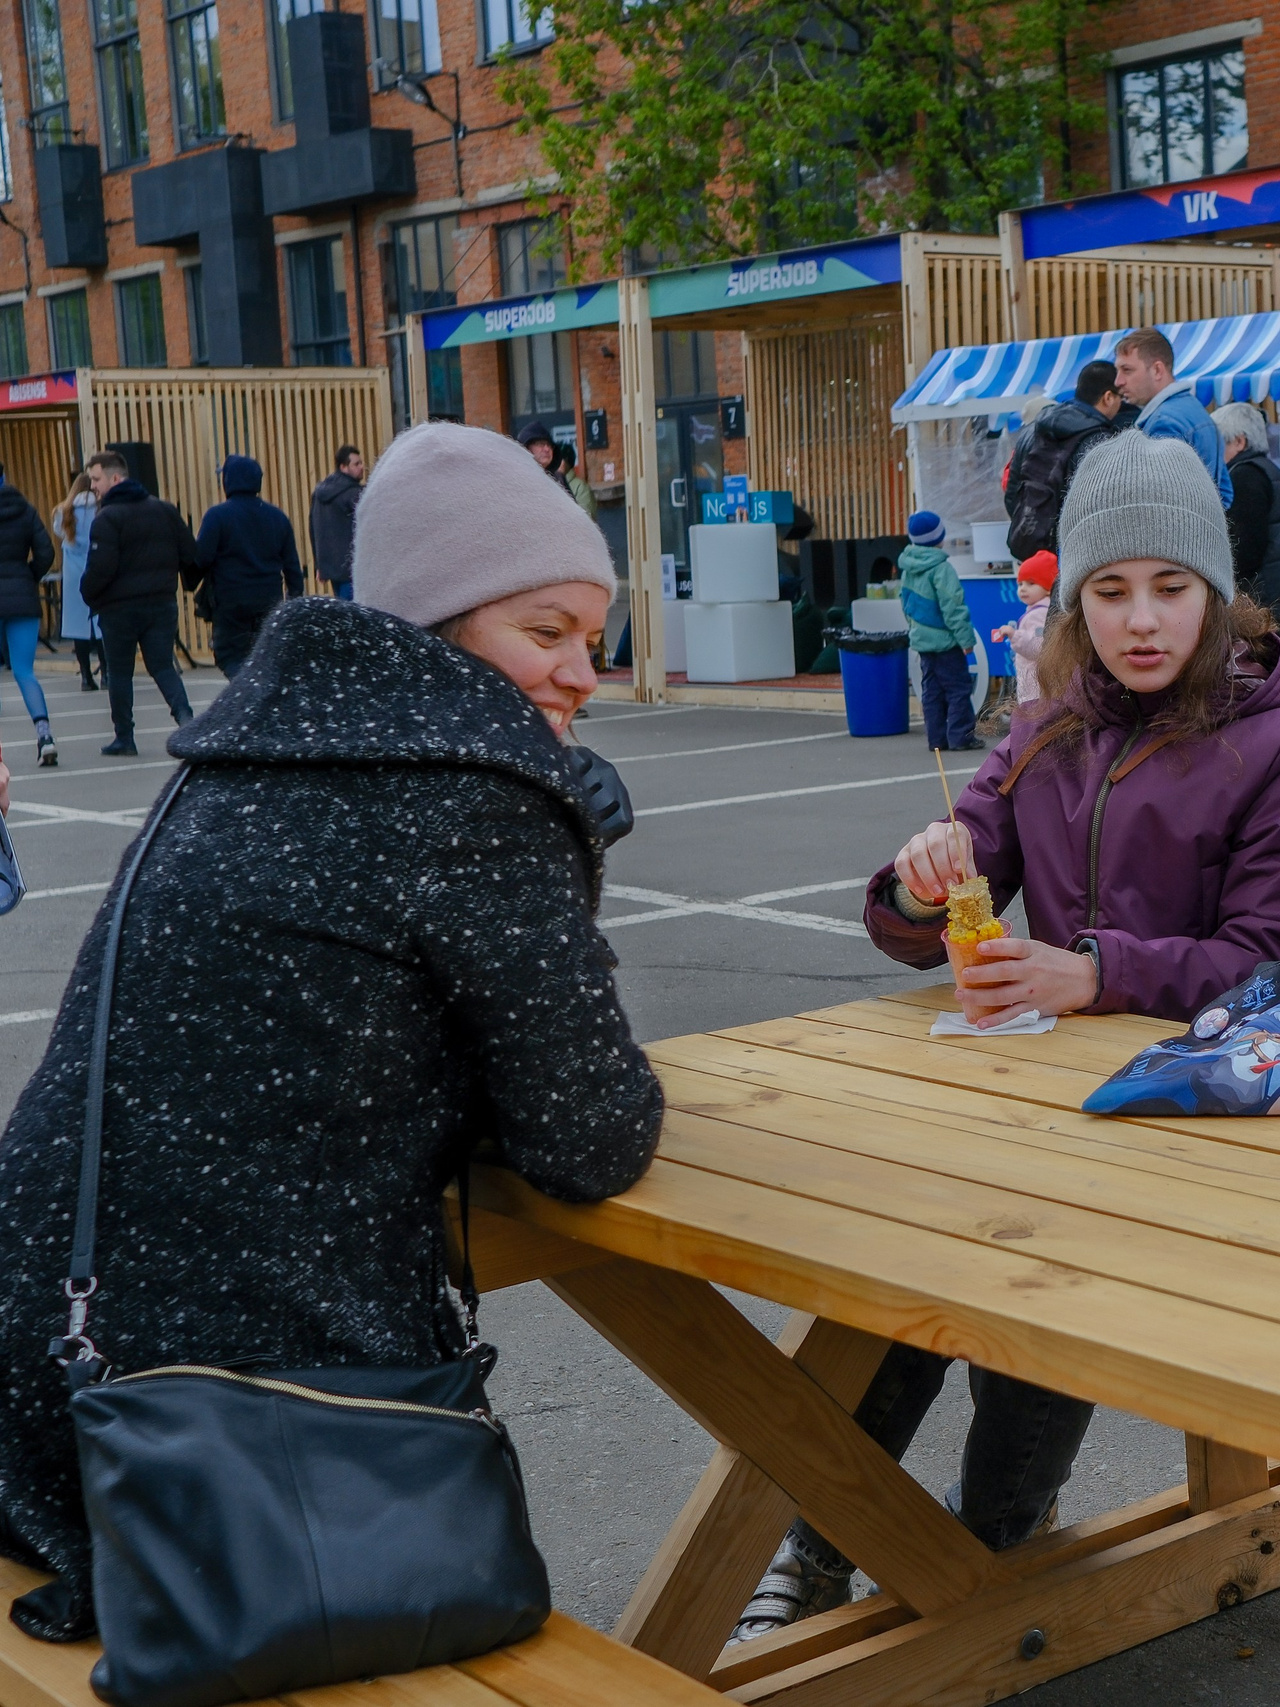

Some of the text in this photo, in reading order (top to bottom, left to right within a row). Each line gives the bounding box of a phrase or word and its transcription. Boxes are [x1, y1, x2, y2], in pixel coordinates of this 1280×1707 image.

[1183, 190, 1218, 223] VK
[728, 260, 817, 297] SUPERJOB
[485, 301, 555, 332] SUPERJOB
[591, 420, 599, 436] 6
[728, 407, 736, 424] 7
